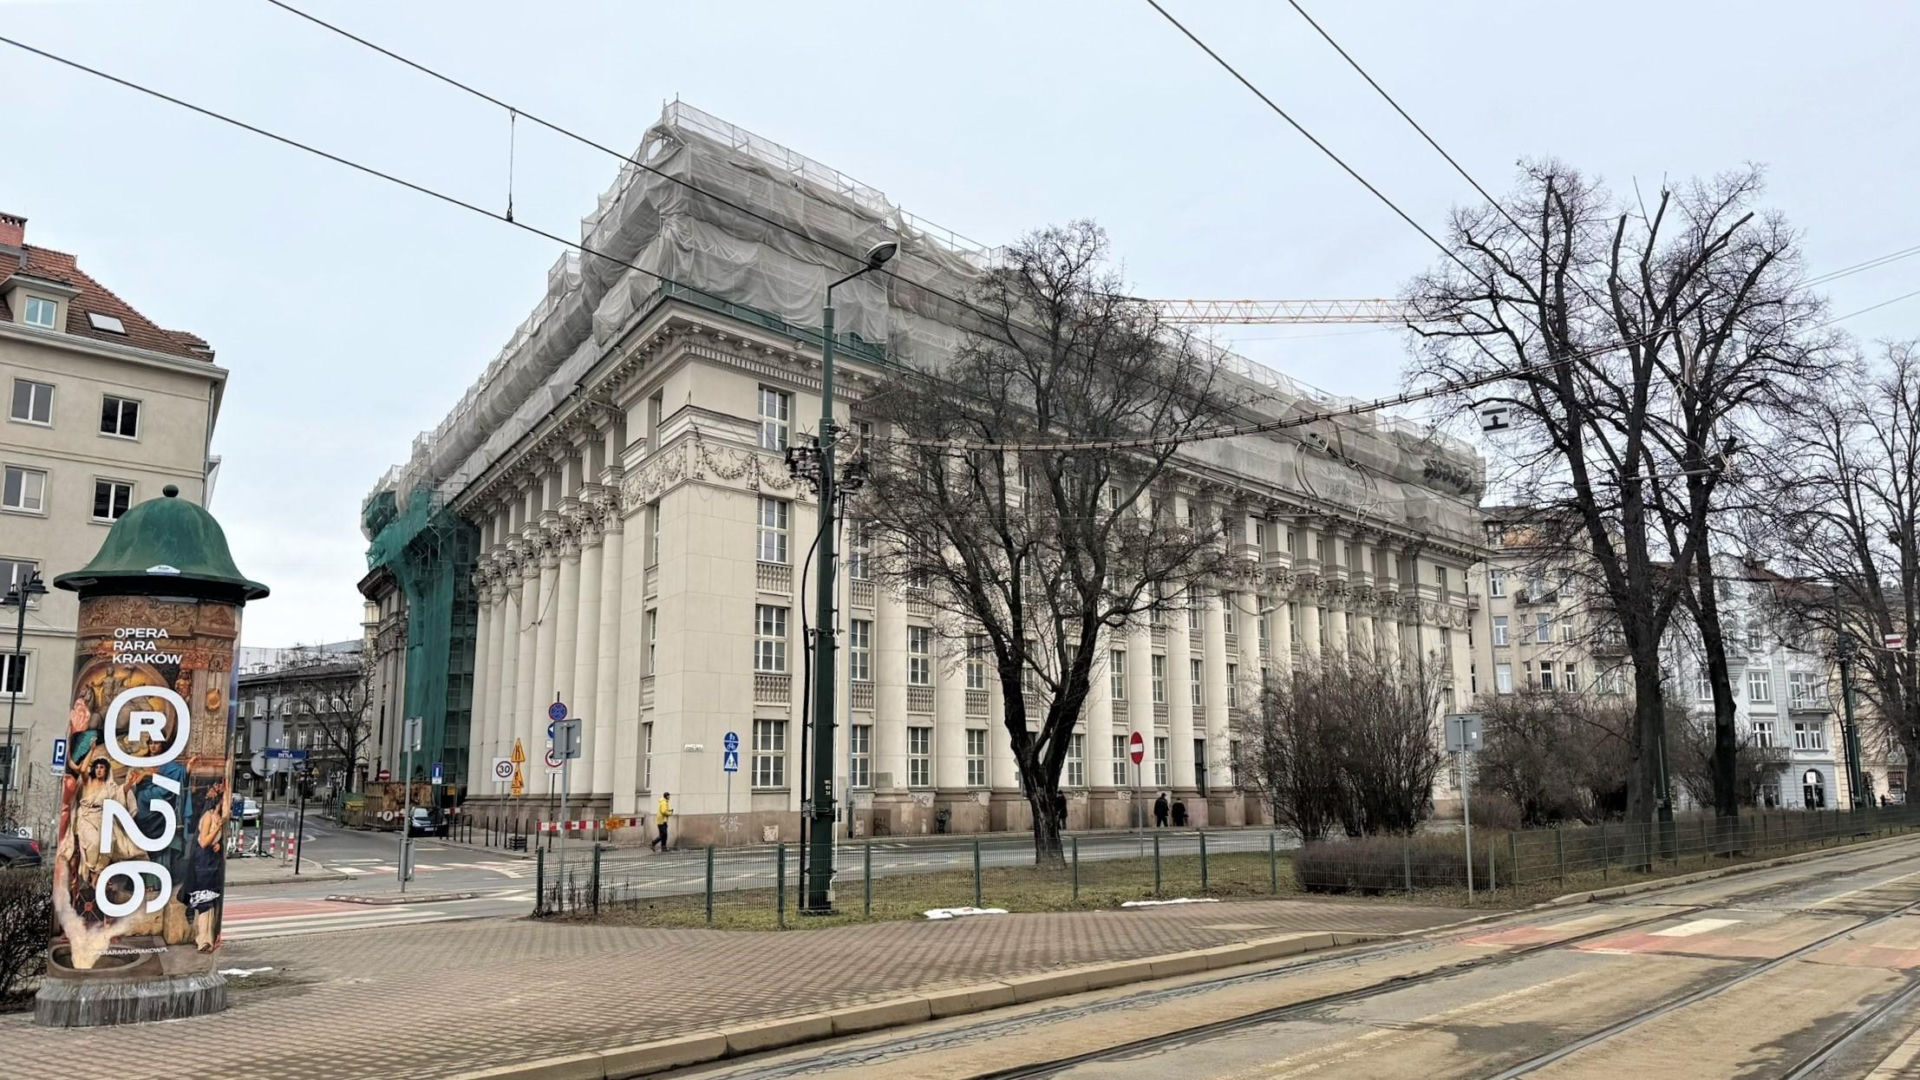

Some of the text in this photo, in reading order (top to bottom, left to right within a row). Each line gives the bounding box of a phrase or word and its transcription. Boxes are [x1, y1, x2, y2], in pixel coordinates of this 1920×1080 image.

[113, 627, 169, 638] OPERA
[113, 640, 157, 651] RARA
[112, 651, 183, 665] KRAKÓW
[55, 741, 65, 762] P
[499, 765, 511, 774] 30
